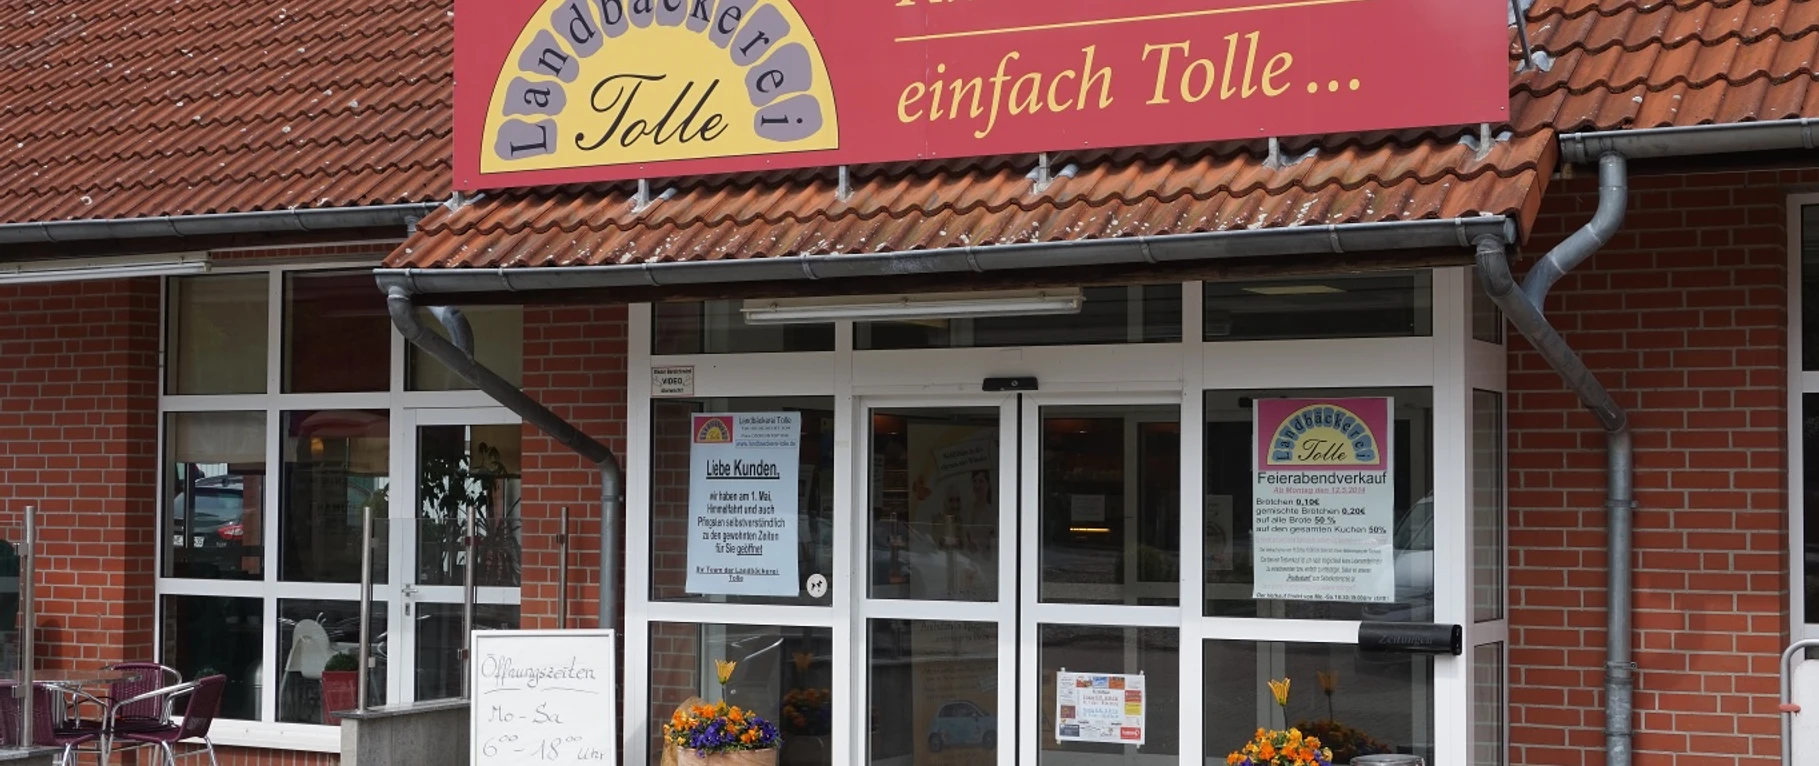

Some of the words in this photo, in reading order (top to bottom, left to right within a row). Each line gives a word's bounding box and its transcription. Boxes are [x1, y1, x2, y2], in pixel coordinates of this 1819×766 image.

[897, 45, 1114, 139] einfach
[575, 73, 729, 151] Tolle
[661, 377, 683, 385] VIDEO
[777, 416, 792, 424] Tolle
[1275, 411, 1375, 461] Landbäckerei
[1297, 438, 1348, 462] Tolle
[706, 459, 731, 476] Liebe
[733, 459, 780, 478] Kunden,
[1257, 471, 1387, 485] Feierabendverkauf
[709, 491, 718, 501] wir
[718, 491, 737, 501] haben
[739, 493, 749, 501] am
[1286, 487, 1314, 495] Montag
[706, 504, 743, 514] Himmelfahrt
[744, 504, 757, 514] und
[758, 504, 775, 514] auch
[1256, 508, 1299, 516] gemischte
[697, 516, 725, 529] Pfingsten
[725, 517, 786, 528] selbstverständlich
[702, 532, 709, 540] zu
[710, 530, 721, 540] den
[723, 530, 757, 542] gewohnten
[757, 530, 779, 541] Zeiten
[1290, 526, 1332, 534] gesamten
[715, 543, 724, 553] für
[725, 543, 736, 553] Sie
[736, 543, 763, 555] geöffnet
[1379, 631, 1433, 647] Zeitungen
[481, 653, 597, 688] Öffnungszeiten
[488, 705, 515, 722] Mo
[532, 701, 564, 724] Sa
